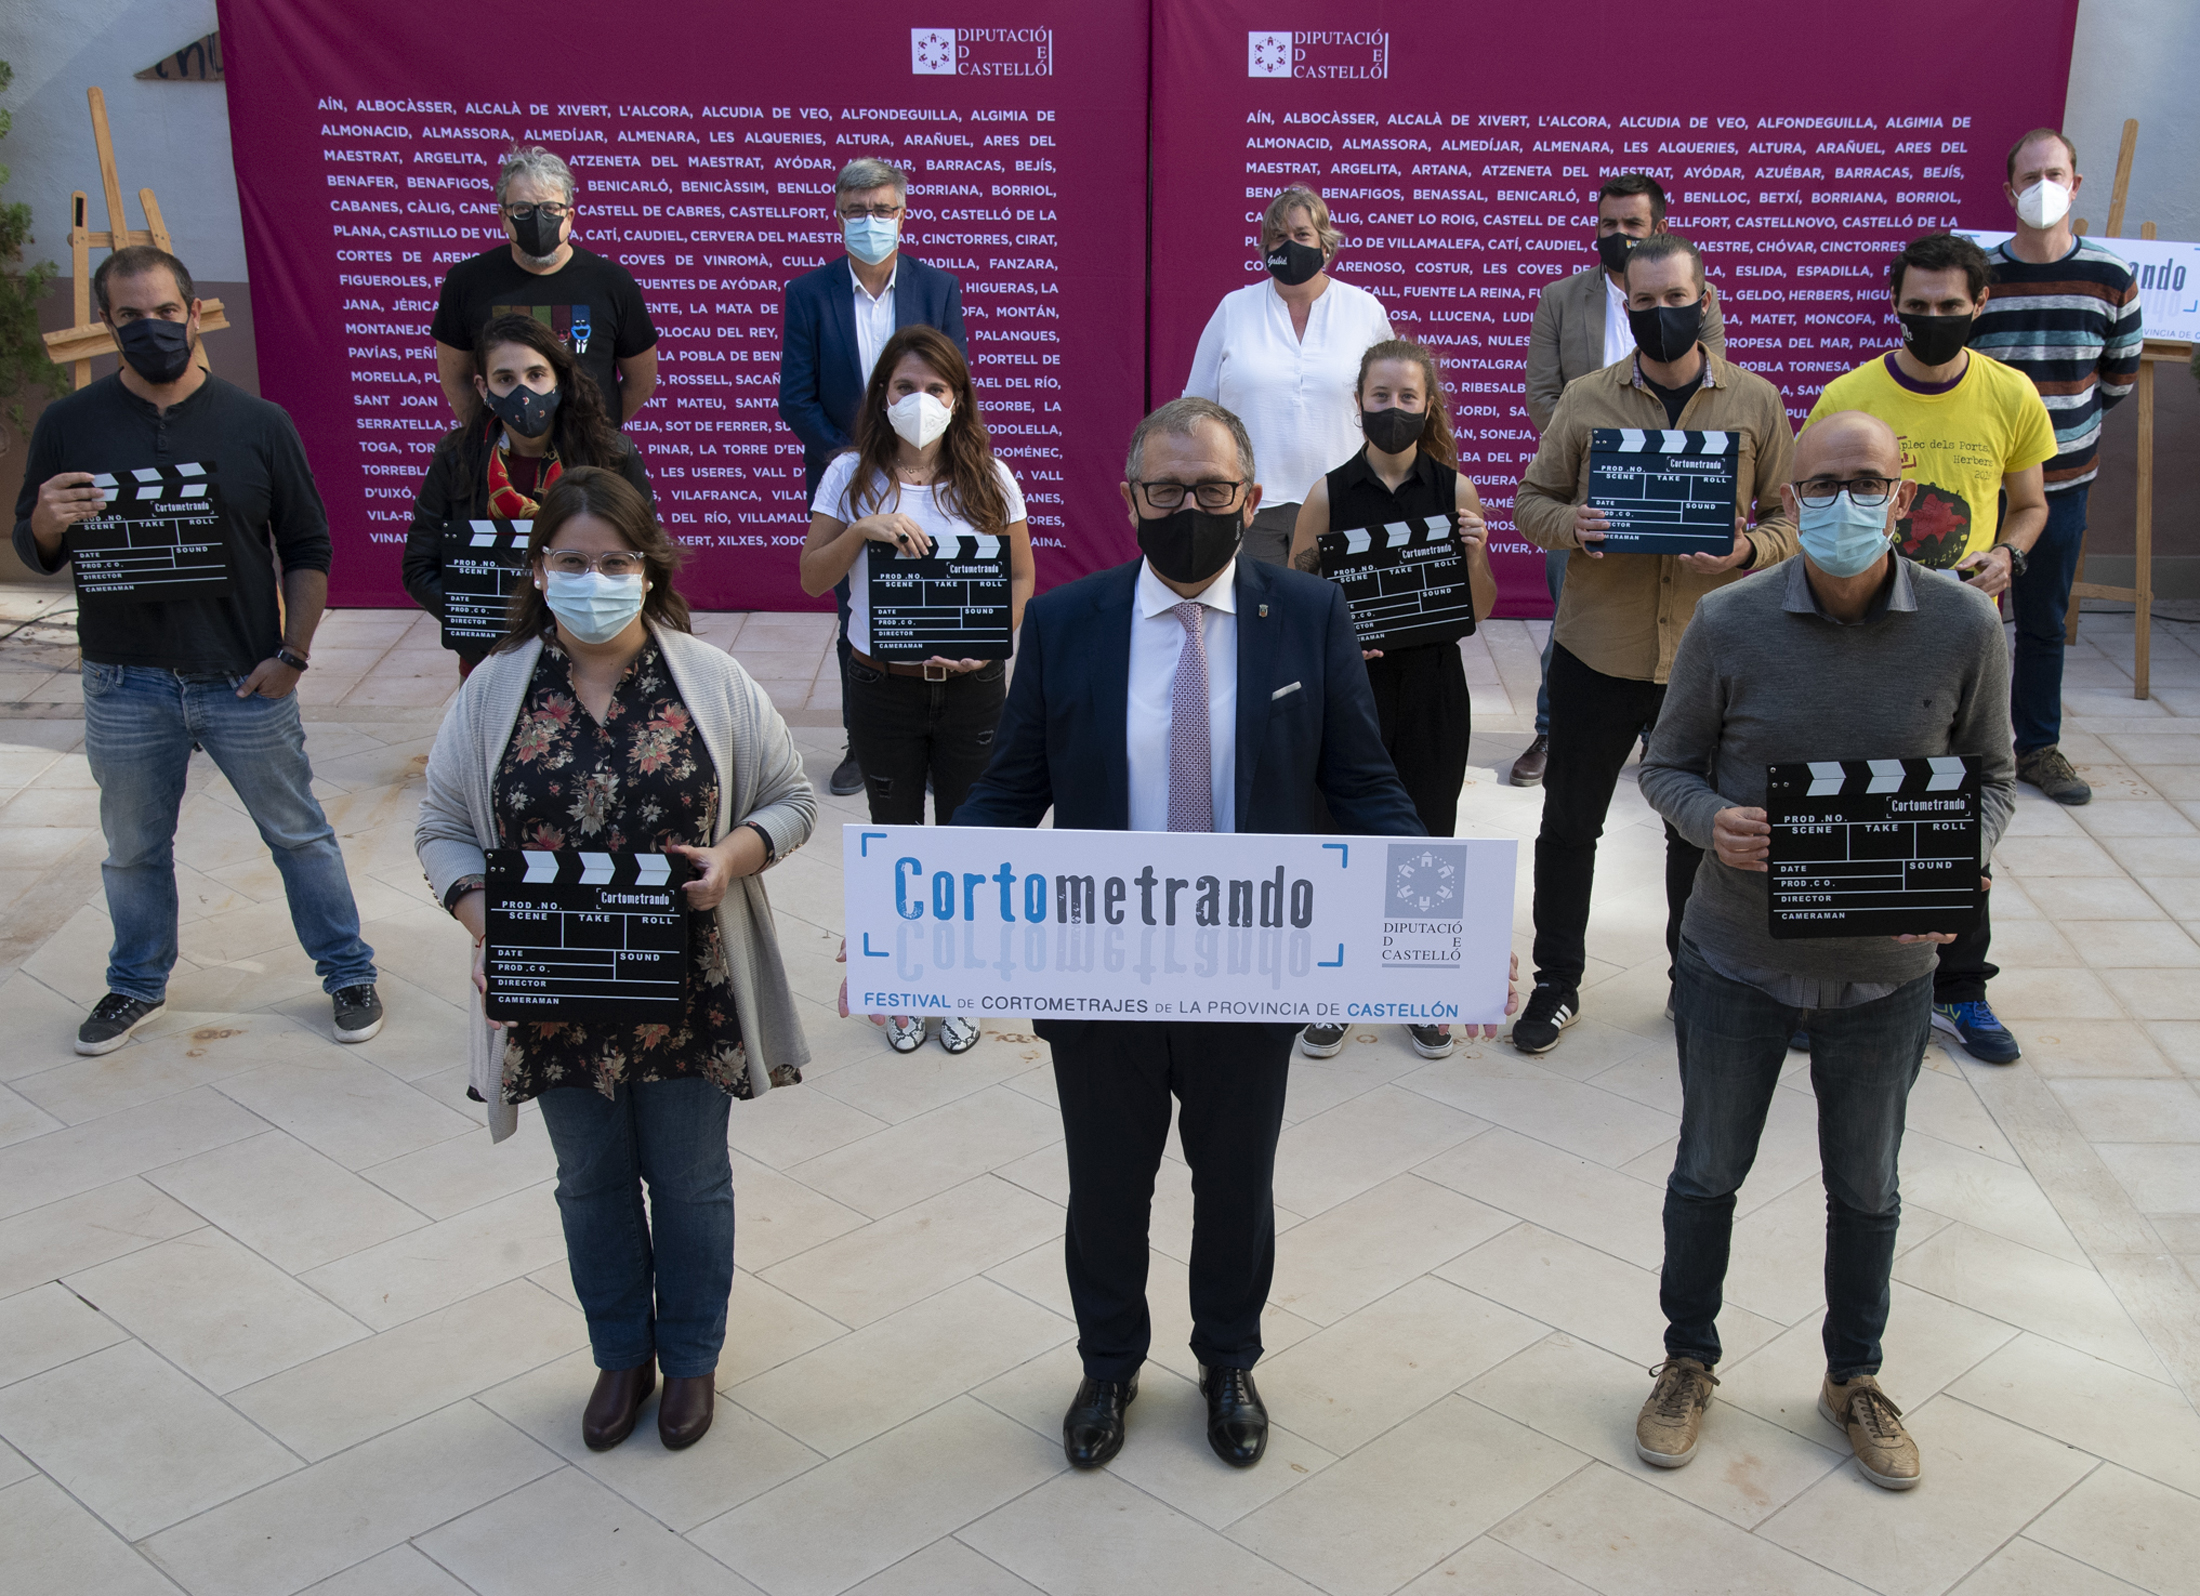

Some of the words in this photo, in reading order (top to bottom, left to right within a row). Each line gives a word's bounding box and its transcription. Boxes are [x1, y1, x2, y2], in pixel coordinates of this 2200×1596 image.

[957, 26, 1047, 42] DIPUTACIÓ
[1294, 29, 1383, 45] DIPUTACIÓ
[958, 60, 1047, 76] CASTELLÓ
[1293, 63, 1383, 79] CASTELLÓ
[318, 97, 347, 112] AÍN,
[357, 99, 456, 115] ALBOCÀSSER,
[466, 101, 521, 115] ALCALÀ
[530, 105, 549, 115] DE
[558, 105, 611, 118] XIVERT,
[620, 106, 693, 119] L'ALCORA,
[702, 107, 764, 118] ALCUDIA
[773, 108, 791, 118] DE
[800, 108, 832, 121] VEO,
[841, 109, 962, 122] ALFONDEGUILLA,
[971, 110, 1028, 121] ALGIMIA
[1037, 111, 1055, 121] DE
[1247, 110, 1274, 125] AÍN,
[1283, 111, 1378, 126] ALBOCÀSSER,
[1387, 112, 1442, 125] ALCALÀ
[1451, 115, 1469, 126] DE
[1478, 115, 1529, 128] XIVERT,
[1539, 116, 1610, 129] L'ALCORA,
[1620, 117, 1680, 127] ALCUDIA
[1690, 117, 1708, 128] DE
[1717, 117, 1748, 130] VEO,
[1757, 118, 1877, 130] ALFONDEGUILLA,
[1886, 117, 1943, 128] ALGIMIA
[1952, 117, 1971, 128] DE
[322, 125, 412, 139] ALMONACID,
[423, 127, 514, 141] ALMASSORA,
[525, 128, 607, 143] ALMEDÍJAR,
[618, 131, 699, 144] ALMENARA,
[710, 132, 734, 143] LES
[745, 133, 826, 146] ALQUERIES,
[836, 134, 894, 147] ALTURA,
[904, 132, 973, 147] ARAÑUEL,
[983, 136, 1019, 146] ARES
[1030, 136, 1056, 146] DEL
[1246, 163, 1320, 175] MAESTRAT,
[1331, 163, 1401, 176] ARGELITA,
[1412, 164, 1471, 177] ARTANA,
[1482, 165, 1552, 176] ATZENETA
[1563, 166, 1589, 177] DEL
[1684, 165, 1744, 180] AYÓDAR,
[1755, 165, 1824, 180] AZUÉBAR,
[1835, 168, 1912, 179] BARRACAS,
[1923, 165, 1964, 179] BEJÍS,
[1322, 188, 1404, 201] BENAFIGOS,
[1413, 189, 1488, 202] BENASSAL,
[1497, 189, 1579, 203] BENICARLÓ,
[1684, 192, 1750, 205] BENLLOC,
[1759, 190, 1802, 205] BETXÍ,
[1811, 193, 1887, 204] BORRIANA,
[1896, 192, 1961, 204] BORRIOL,
[331, 201, 402, 214] CABANES,
[730, 207, 828, 220] CASTELLFORT,
[941, 207, 1011, 220] CASTELLÓ
[1736, 217, 1837, 229] CASTELLNOVO,
[922, 234, 1012, 246] CINCTORRES,
[1016, 235, 1057, 246] CIRAT,
[1388, 238, 1484, 251] VILLAMALEFA,
[1757, 239, 1816, 254] CHÓVAR,
[337, 250, 392, 262] CORTES
[704, 253, 772, 268] VINROMÀ,
[990, 259, 1058, 271] FANZARA,
[1336, 262, 1405, 274] ARENOSO,
[1415, 263, 1473, 275] COSTUR,
[1736, 266, 1786, 278] ESLIDA,
[1797, 266, 1873, 277] ESPADILLA,
[340, 275, 431, 289] FIGUEROLES,
[966, 283, 1038, 295] HIGUERAS,
[1404, 287, 1456, 297] FUENTE
[1736, 290, 1785, 302] GELDO,
[1789, 290, 1853, 302] HERBERS,
[343, 300, 384, 312] JANA,
[997, 305, 1059, 319] MONTÁN,
[1430, 311, 1495, 323] LLUCENA,
[1751, 314, 1796, 326] MATET,
[1805, 314, 1875, 325] MONCOFA,
[976, 331, 1059, 342] PALANQUES,
[1418, 335, 1481, 347] NAVAJAS,
[2179, 330, 2191, 339] DE
[349, 346, 401, 360] PAVÍAS,
[979, 354, 1038, 364] PORTELL
[1789, 362, 1855, 374] TORNESA,
[351, 372, 420, 385] MORELLA,
[354, 395, 390, 405] SANT
[401, 396, 437, 406] JOAN
[357, 419, 447, 431] SERRATELLA,
[716, 422, 771, 433] FERRER,
[359, 442, 402, 454] TOGA,
[993, 445, 1062, 460] DOMÉNEC,
[1930, 440, 1955, 449] dels
[1670, 458, 1721, 470] Cortometrando
[365, 486, 415, 500] D'UIXÓ,
[155, 501, 209, 512] Cortometrando
[1402, 543, 1451, 559] Cortometrando
[950, 565, 999, 574] Cortometrando
[1340, 574, 1368, 583] SCENE
[1423, 588, 1452, 597] SOUND
[1892, 798, 1965, 812] Cortometrando
[1792, 826, 1832, 834] SCENE
[1865, 824, 1899, 833] TAKE
[1933, 822, 1966, 831] ROLL
[1909, 861, 1953, 869] SOUND
[601, 892, 670, 906] Cortometrando
[894, 856, 1314, 929] Cortometrando
[509, 912, 548, 921] SCENE
[579, 914, 610, 922] TAKE
[642, 916, 673, 925] ROLL
[1781, 912, 1845, 920] CAMERAMAN
[1383, 920, 1463, 934] DIPUTACIÓ
[620, 952, 660, 961] SOUND
[1381, 947, 1461, 961] CASTELLÓ
[498, 979, 547, 987] DIRECTOR
[498, 996, 560, 1005] CAMERAMAN
[864, 992, 951, 1009] FESTIVAL
[958, 998, 975, 1009] DE
[981, 995, 1148, 1013] CORTOMETRAJES
[1155, 1002, 1172, 1014] DE
[1179, 1001, 1201, 1014] LA
[1208, 1001, 1310, 1016] PROVINCIA
[1316, 1002, 1340, 1016] DE
[1347, 1000, 1459, 1018] CASTELLÓN
